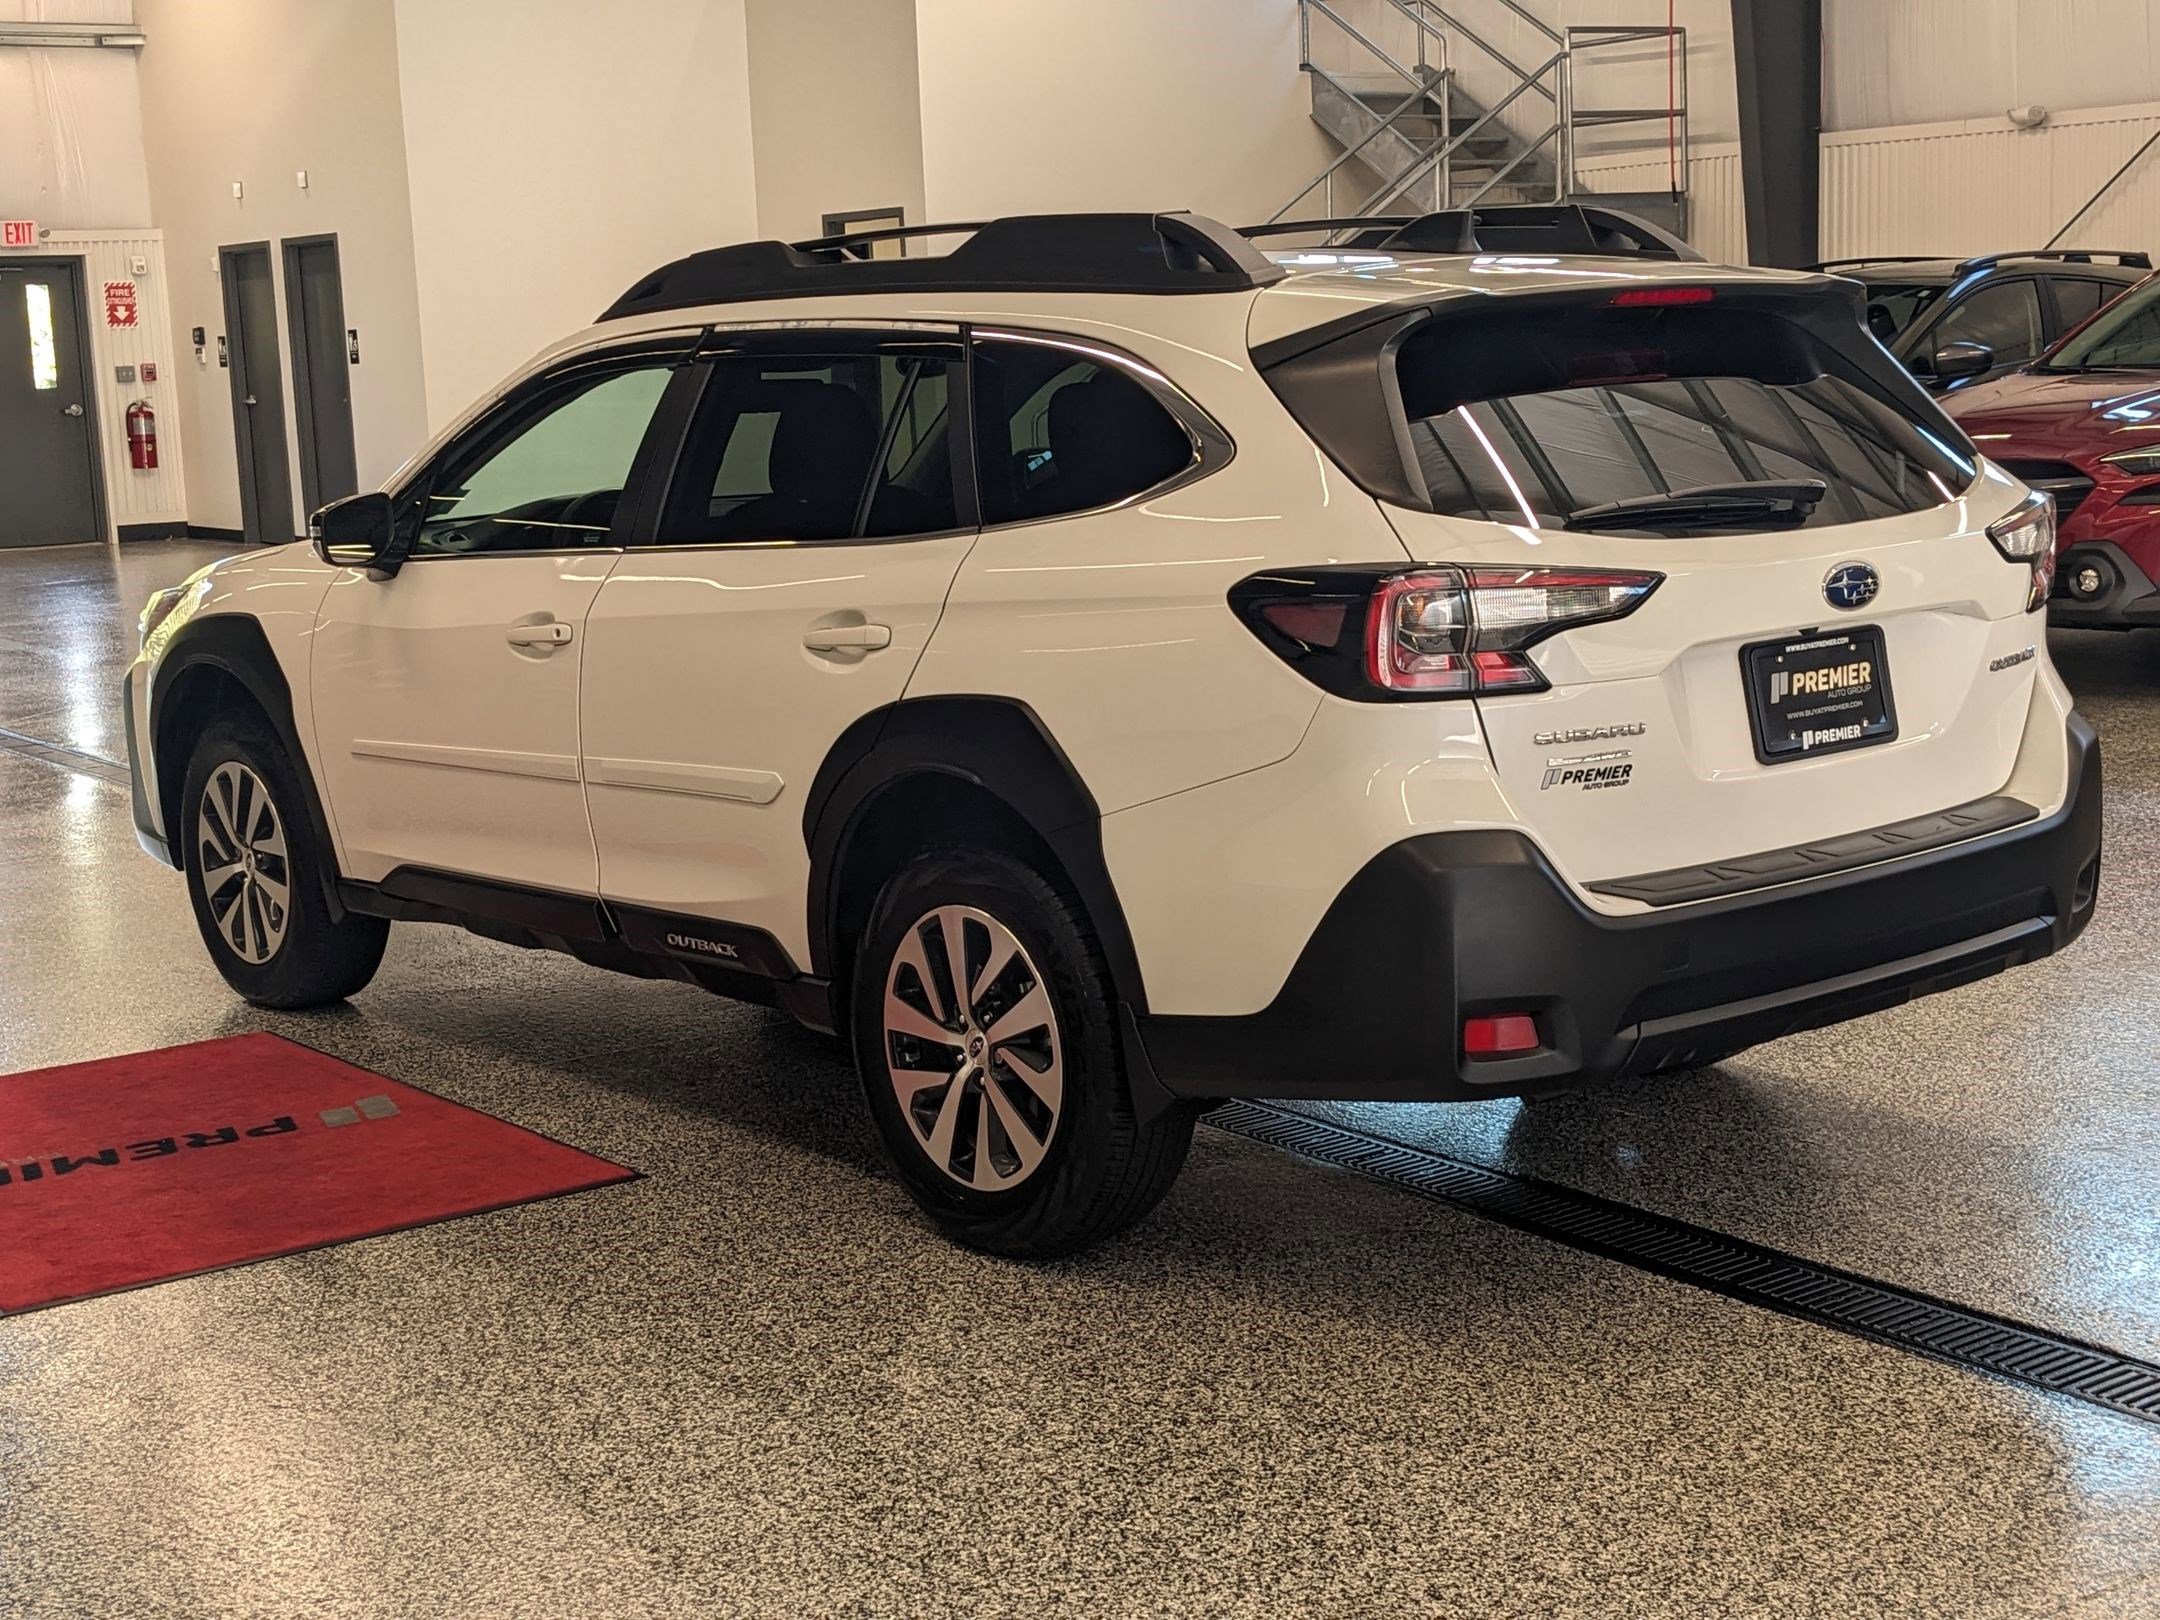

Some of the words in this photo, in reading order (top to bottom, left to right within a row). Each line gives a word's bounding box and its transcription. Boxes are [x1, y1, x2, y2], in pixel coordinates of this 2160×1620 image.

[5, 222, 33, 244] EXIT
[110, 288, 130, 297] FIRE
[1792, 661, 1872, 696] PREMIER
[1827, 689, 1846, 699] AUTO
[1847, 684, 1872, 696] GROUP
[1786, 700, 1864, 719] WWW.BUYATPREMIER.COM
[1533, 722, 1647, 745] SUBARU
[1814, 724, 1862, 745] PREMIER
[1561, 764, 1633, 785] PREMIER
[1582, 781, 1603, 791] AUTO
[1603, 779, 1630, 789] GROUP
[666, 933, 738, 958] OUTBACK
